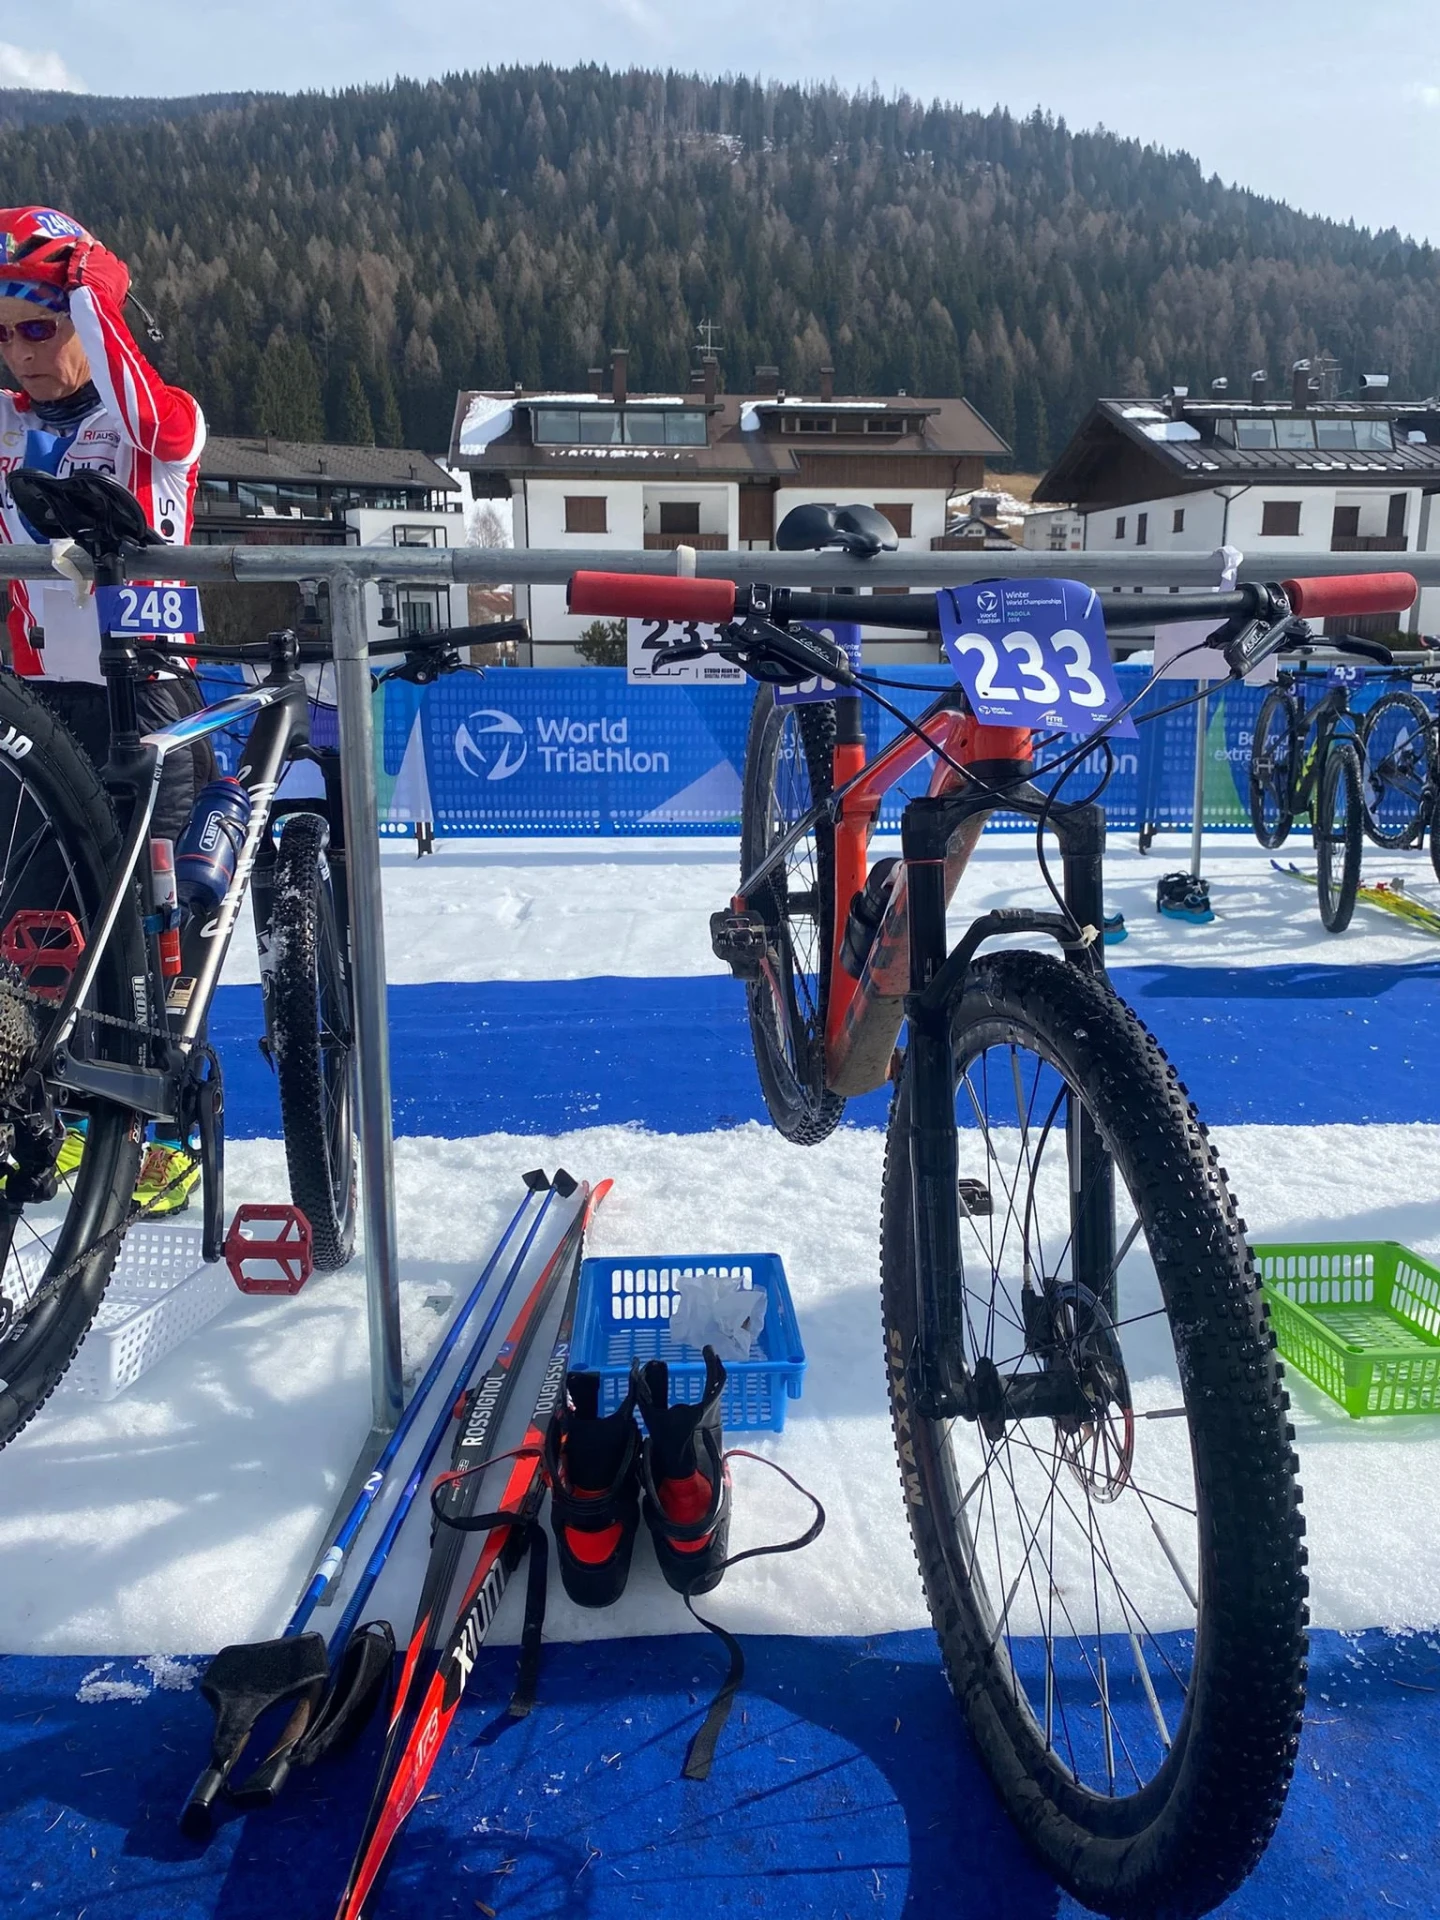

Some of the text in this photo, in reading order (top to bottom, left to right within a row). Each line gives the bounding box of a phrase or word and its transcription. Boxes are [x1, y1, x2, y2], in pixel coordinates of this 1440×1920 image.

[37, 213, 76, 235] 248
[119, 589, 183, 629] 248
[1005, 591, 1030, 599] Winter
[953, 629, 1107, 708] 233
[1333, 667, 1357, 681] 43
[537, 717, 627, 744] World
[537, 747, 669, 773] Triathlon
[207, 814, 222, 848] ABUS
[132, 975, 148, 1026] IKON
[556, 1343, 568, 1357] 2
[533, 1357, 567, 1420] OSSIGNOL
[461, 1373, 507, 1447] ROSSIGNOL
[889, 1328, 925, 1507] MAXXIS
[415, 1706, 439, 1766] 173
